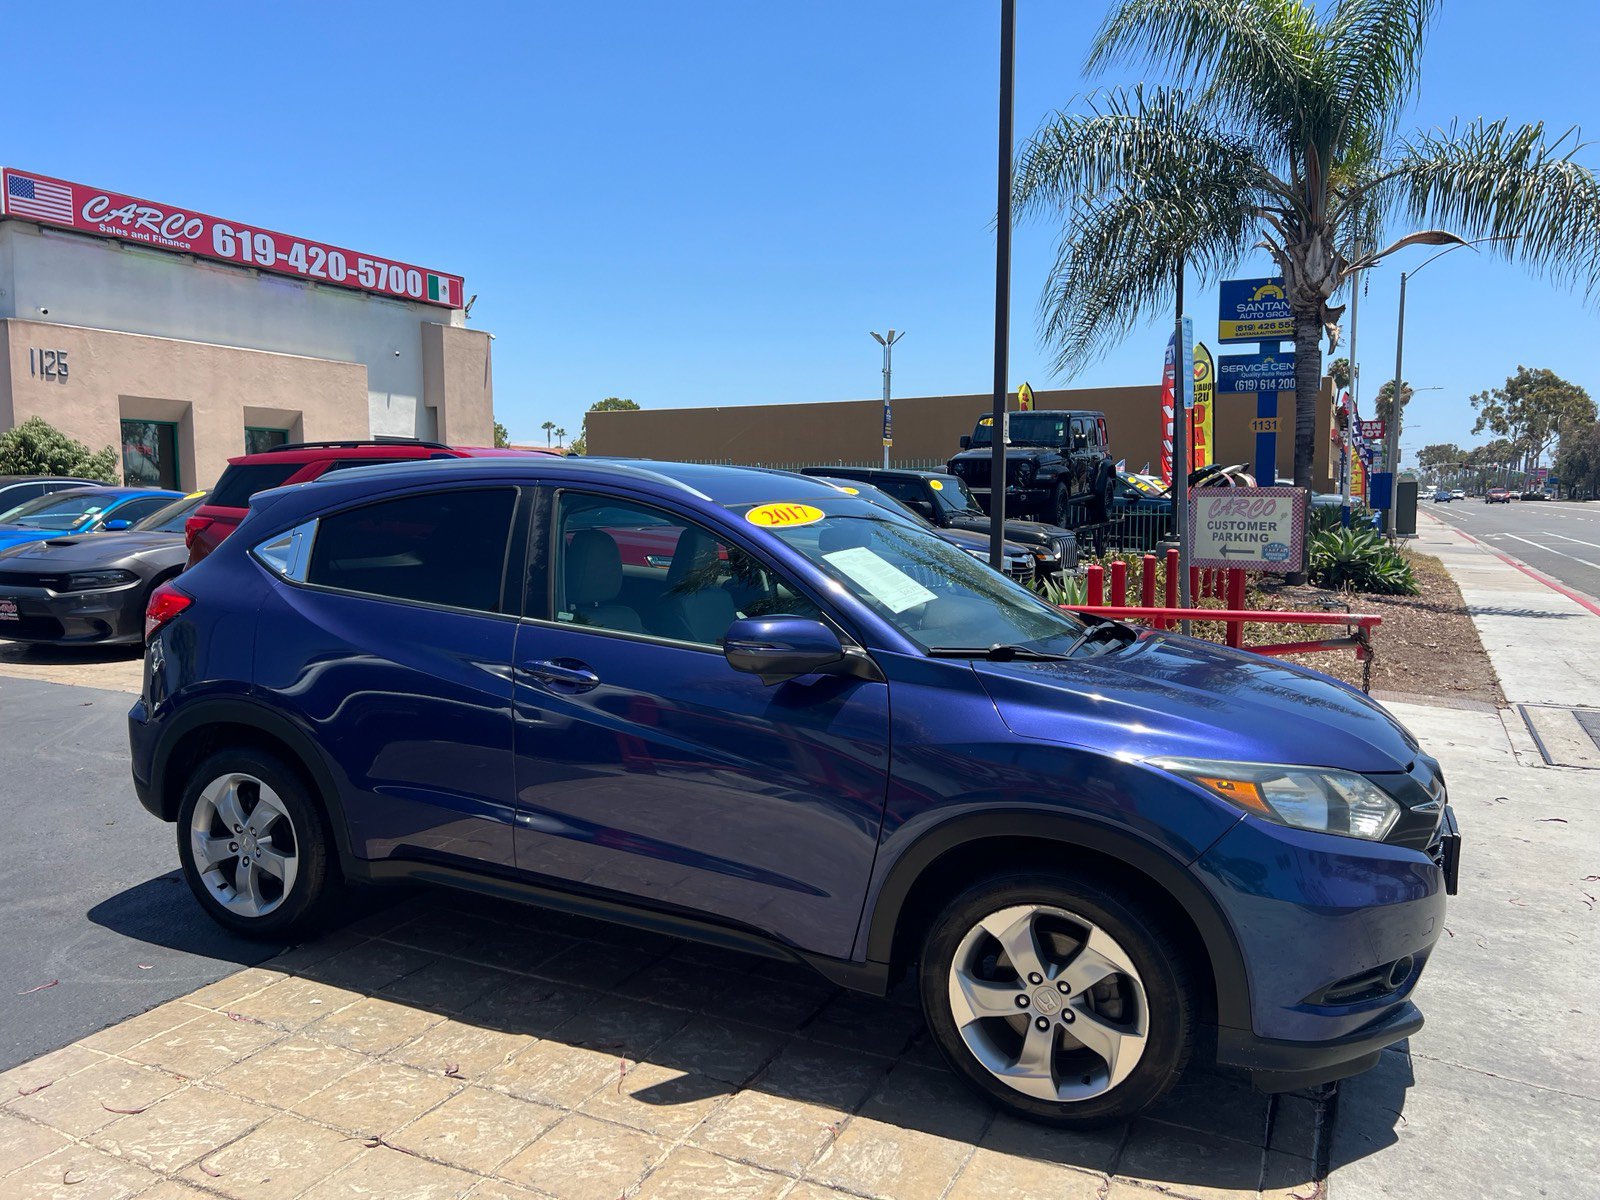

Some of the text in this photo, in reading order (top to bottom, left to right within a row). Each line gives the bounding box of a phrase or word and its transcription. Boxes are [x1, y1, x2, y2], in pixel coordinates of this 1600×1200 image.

[81, 195, 204, 240] CARCO
[99, 223, 191, 250] Sales and Finance
[212, 223, 423, 298] 619-420-5700
[1239, 312, 1264, 320] AUTO
[1235, 324, 1256, 332] (619)
[1258, 322, 1276, 330] 426
[30, 347, 69, 378] 1125
[1221, 363, 1269, 373] SERVICE
[1235, 379, 1258, 391] (619)
[1260, 379, 1276, 390] 614
[1252, 420, 1277, 430] 1131
[1208, 498, 1277, 520] CARCO
[762, 506, 809, 525] 2017
[1207, 521, 1277, 532] CUSTOMER
[1212, 532, 1269, 543] PARKING
